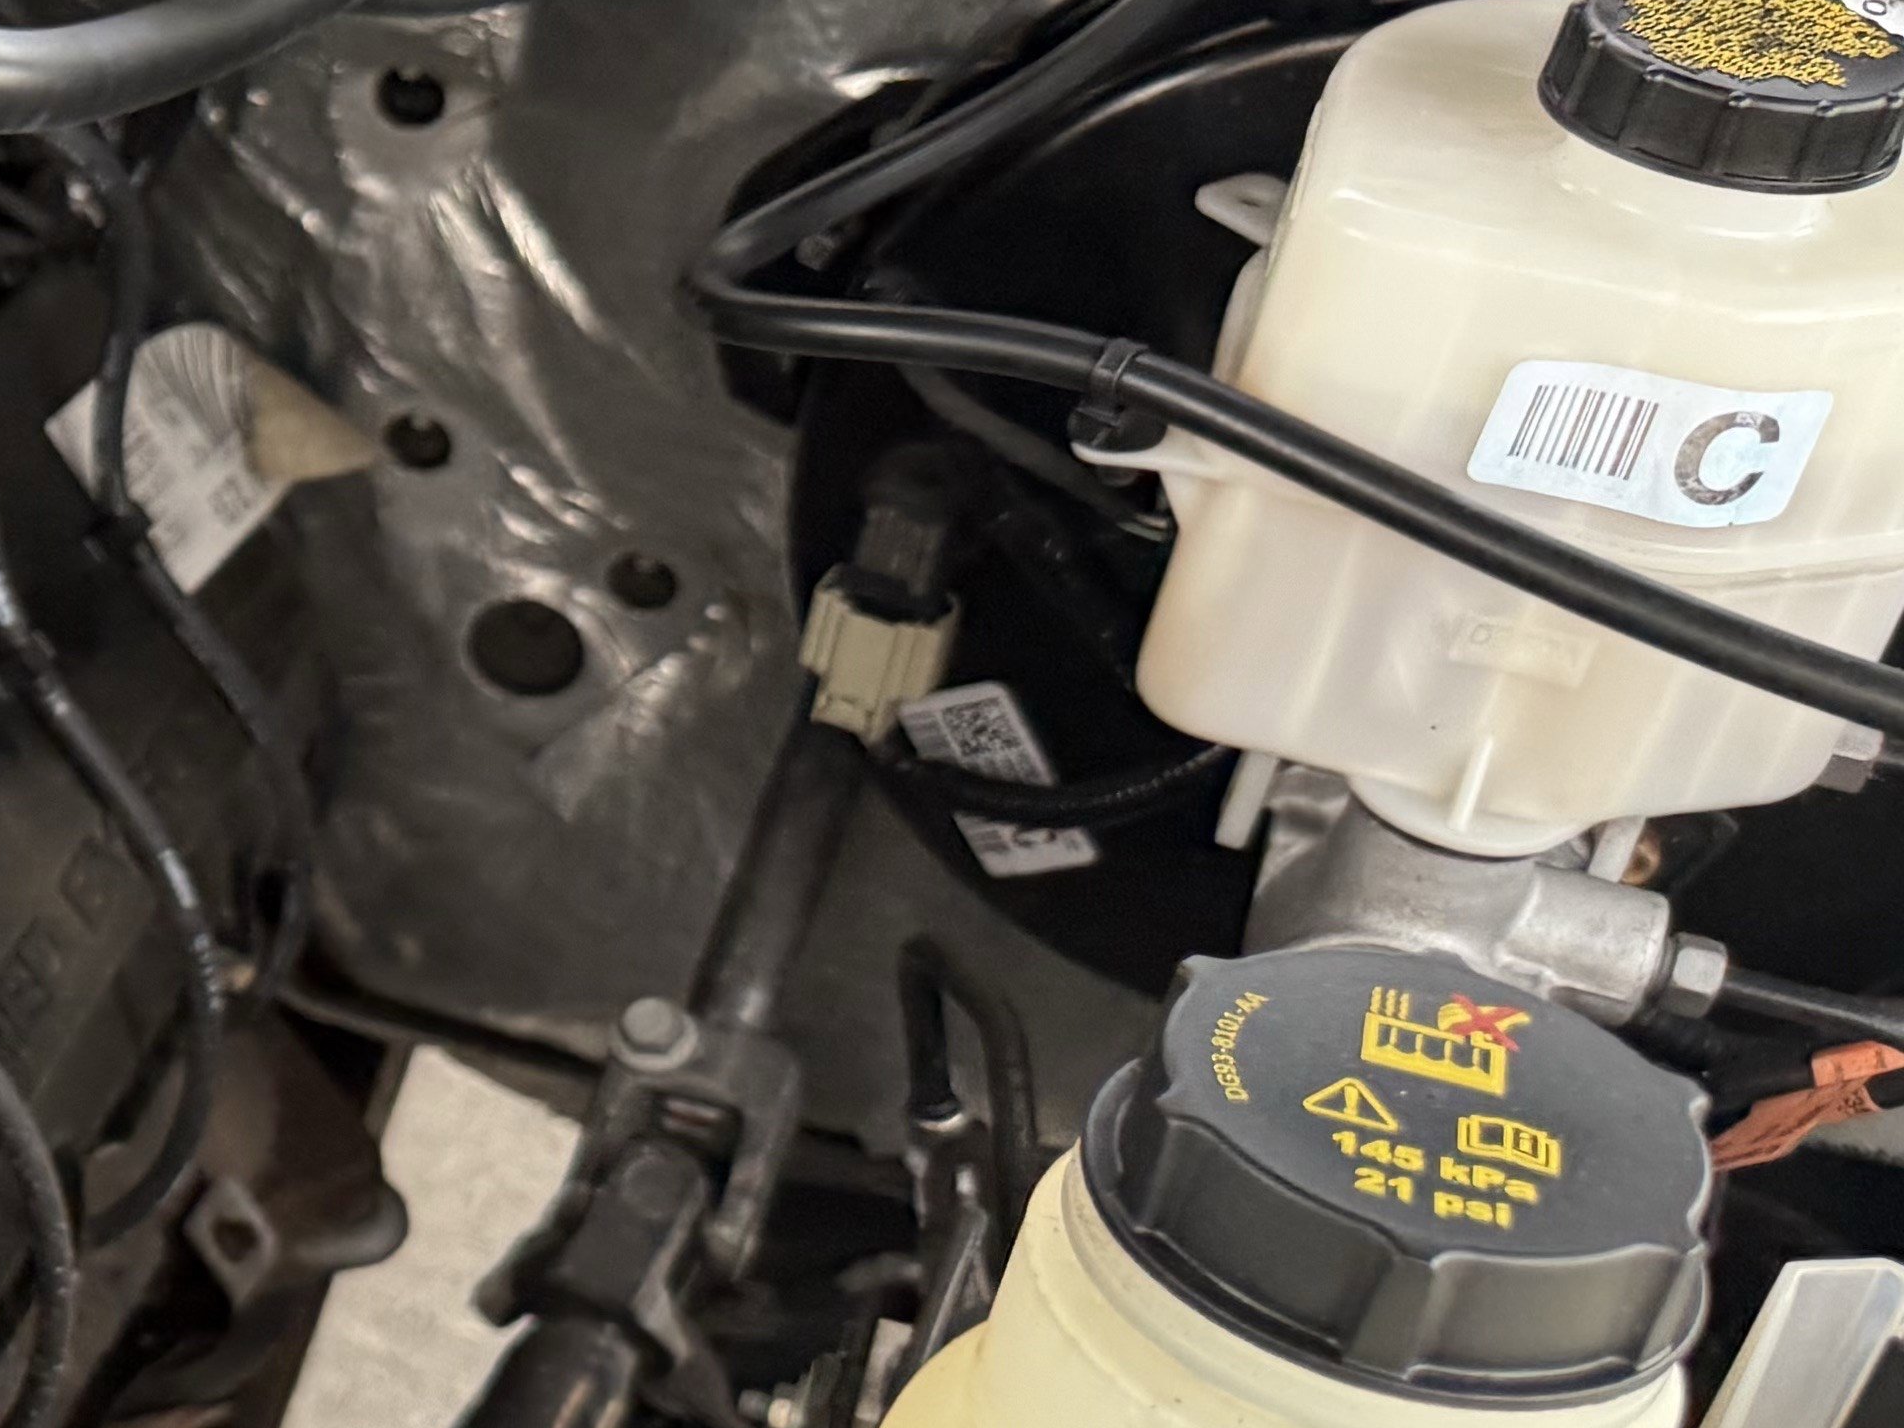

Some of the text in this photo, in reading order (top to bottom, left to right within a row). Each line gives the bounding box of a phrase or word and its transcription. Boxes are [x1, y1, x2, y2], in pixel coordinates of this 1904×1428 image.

[1674, 410, 1770, 506] C
[1332, 1130, 1539, 1206] 145 kPa
[1354, 1166, 1512, 1230] 21 psi
